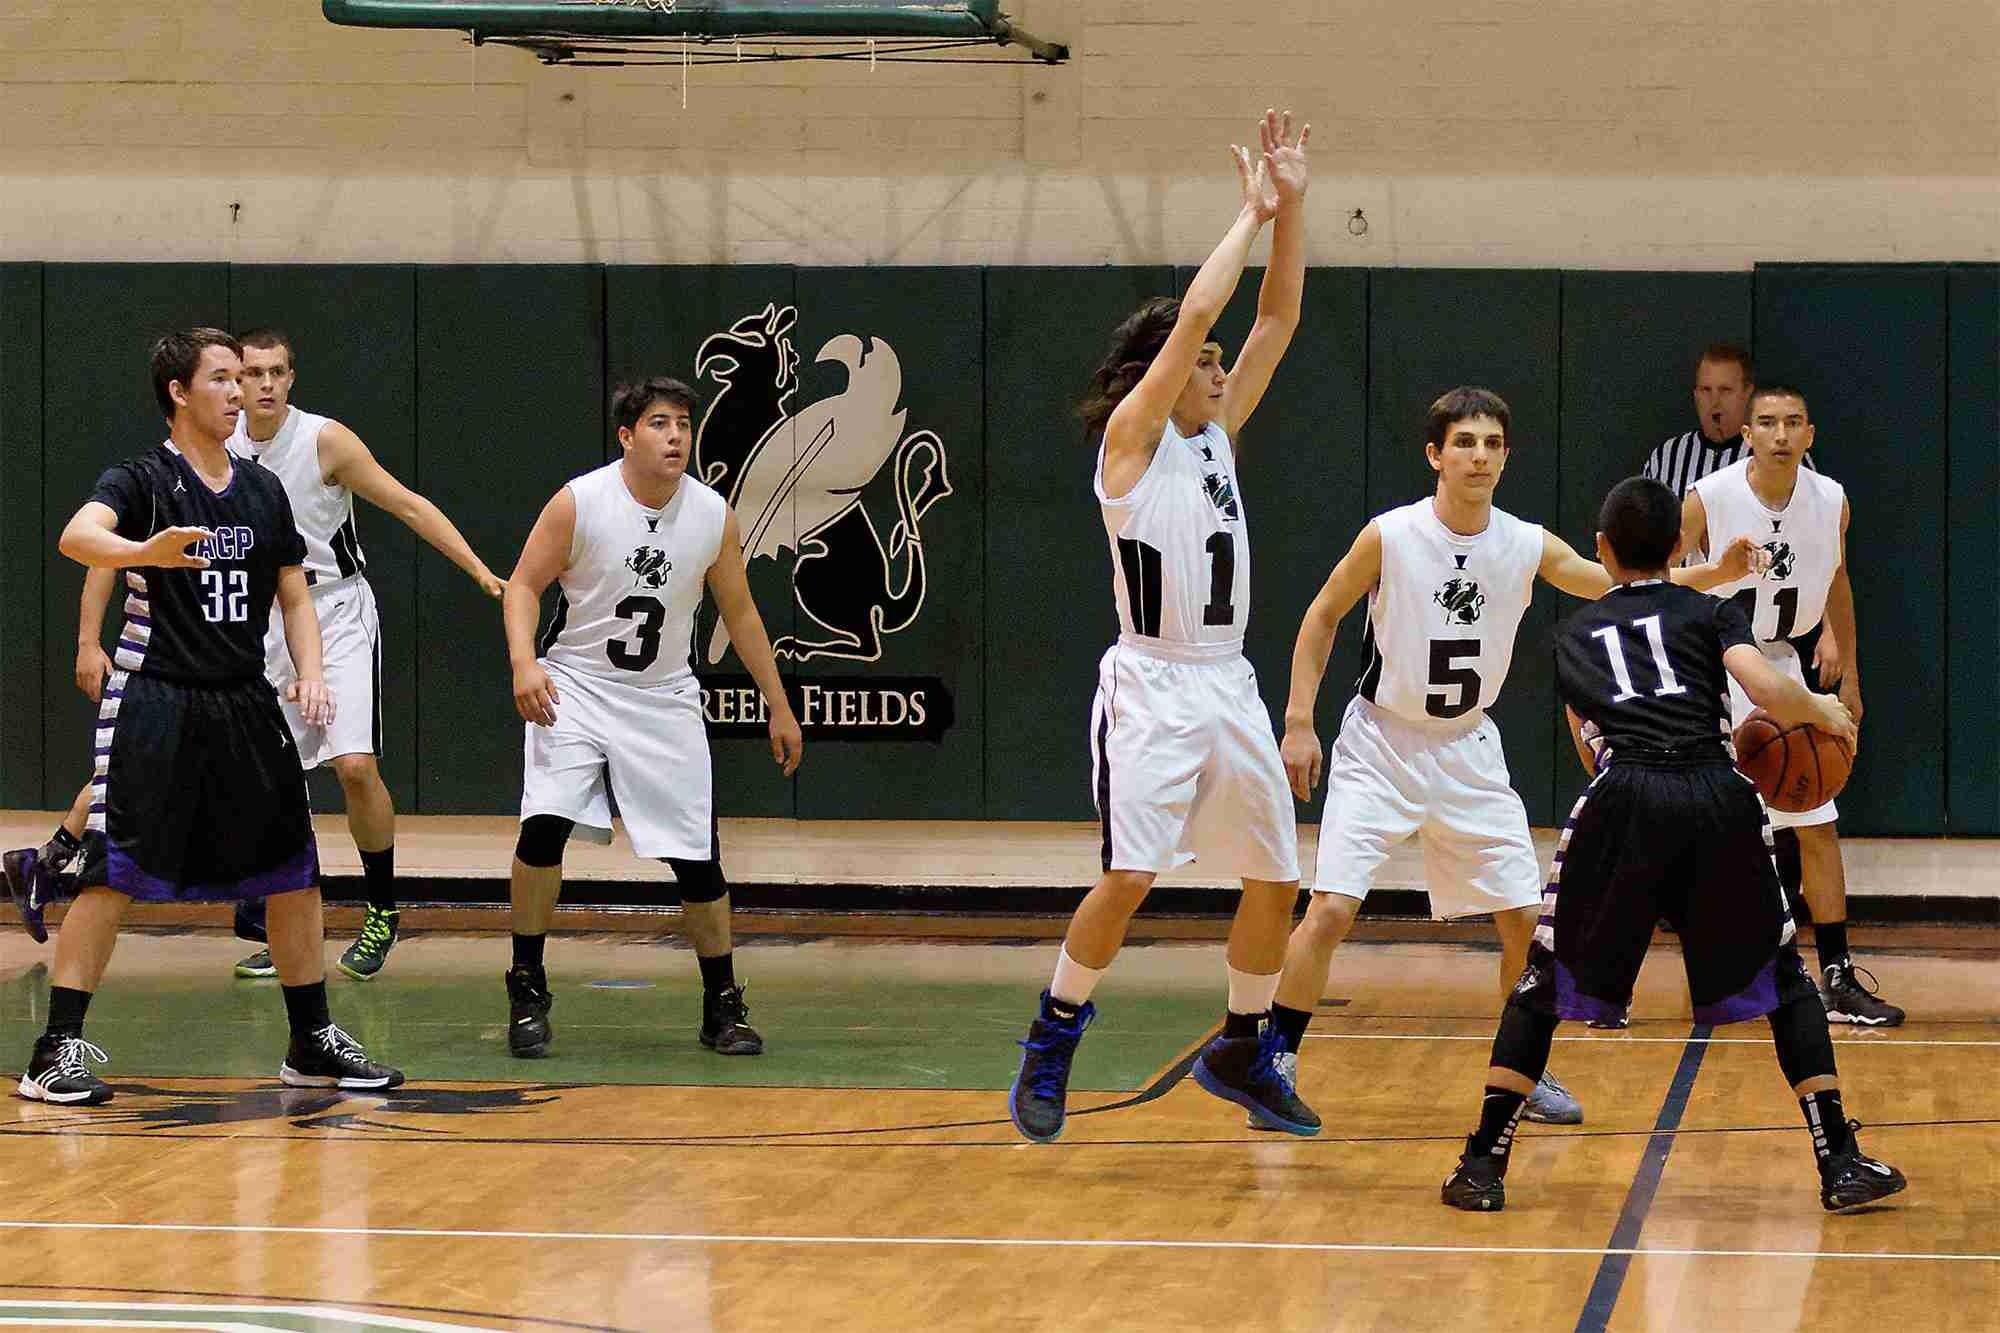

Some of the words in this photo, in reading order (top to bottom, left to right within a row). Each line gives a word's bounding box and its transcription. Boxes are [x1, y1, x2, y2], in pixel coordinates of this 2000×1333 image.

[196, 526, 254, 560] ACP
[1203, 530, 1235, 626] 1
[200, 570, 248, 622] 32
[606, 595, 665, 672] 3
[1425, 639, 1482, 719] 5
[1591, 615, 1687, 702] 11
[699, 688, 768, 723] REE
[800, 685, 926, 727] FIELDS
